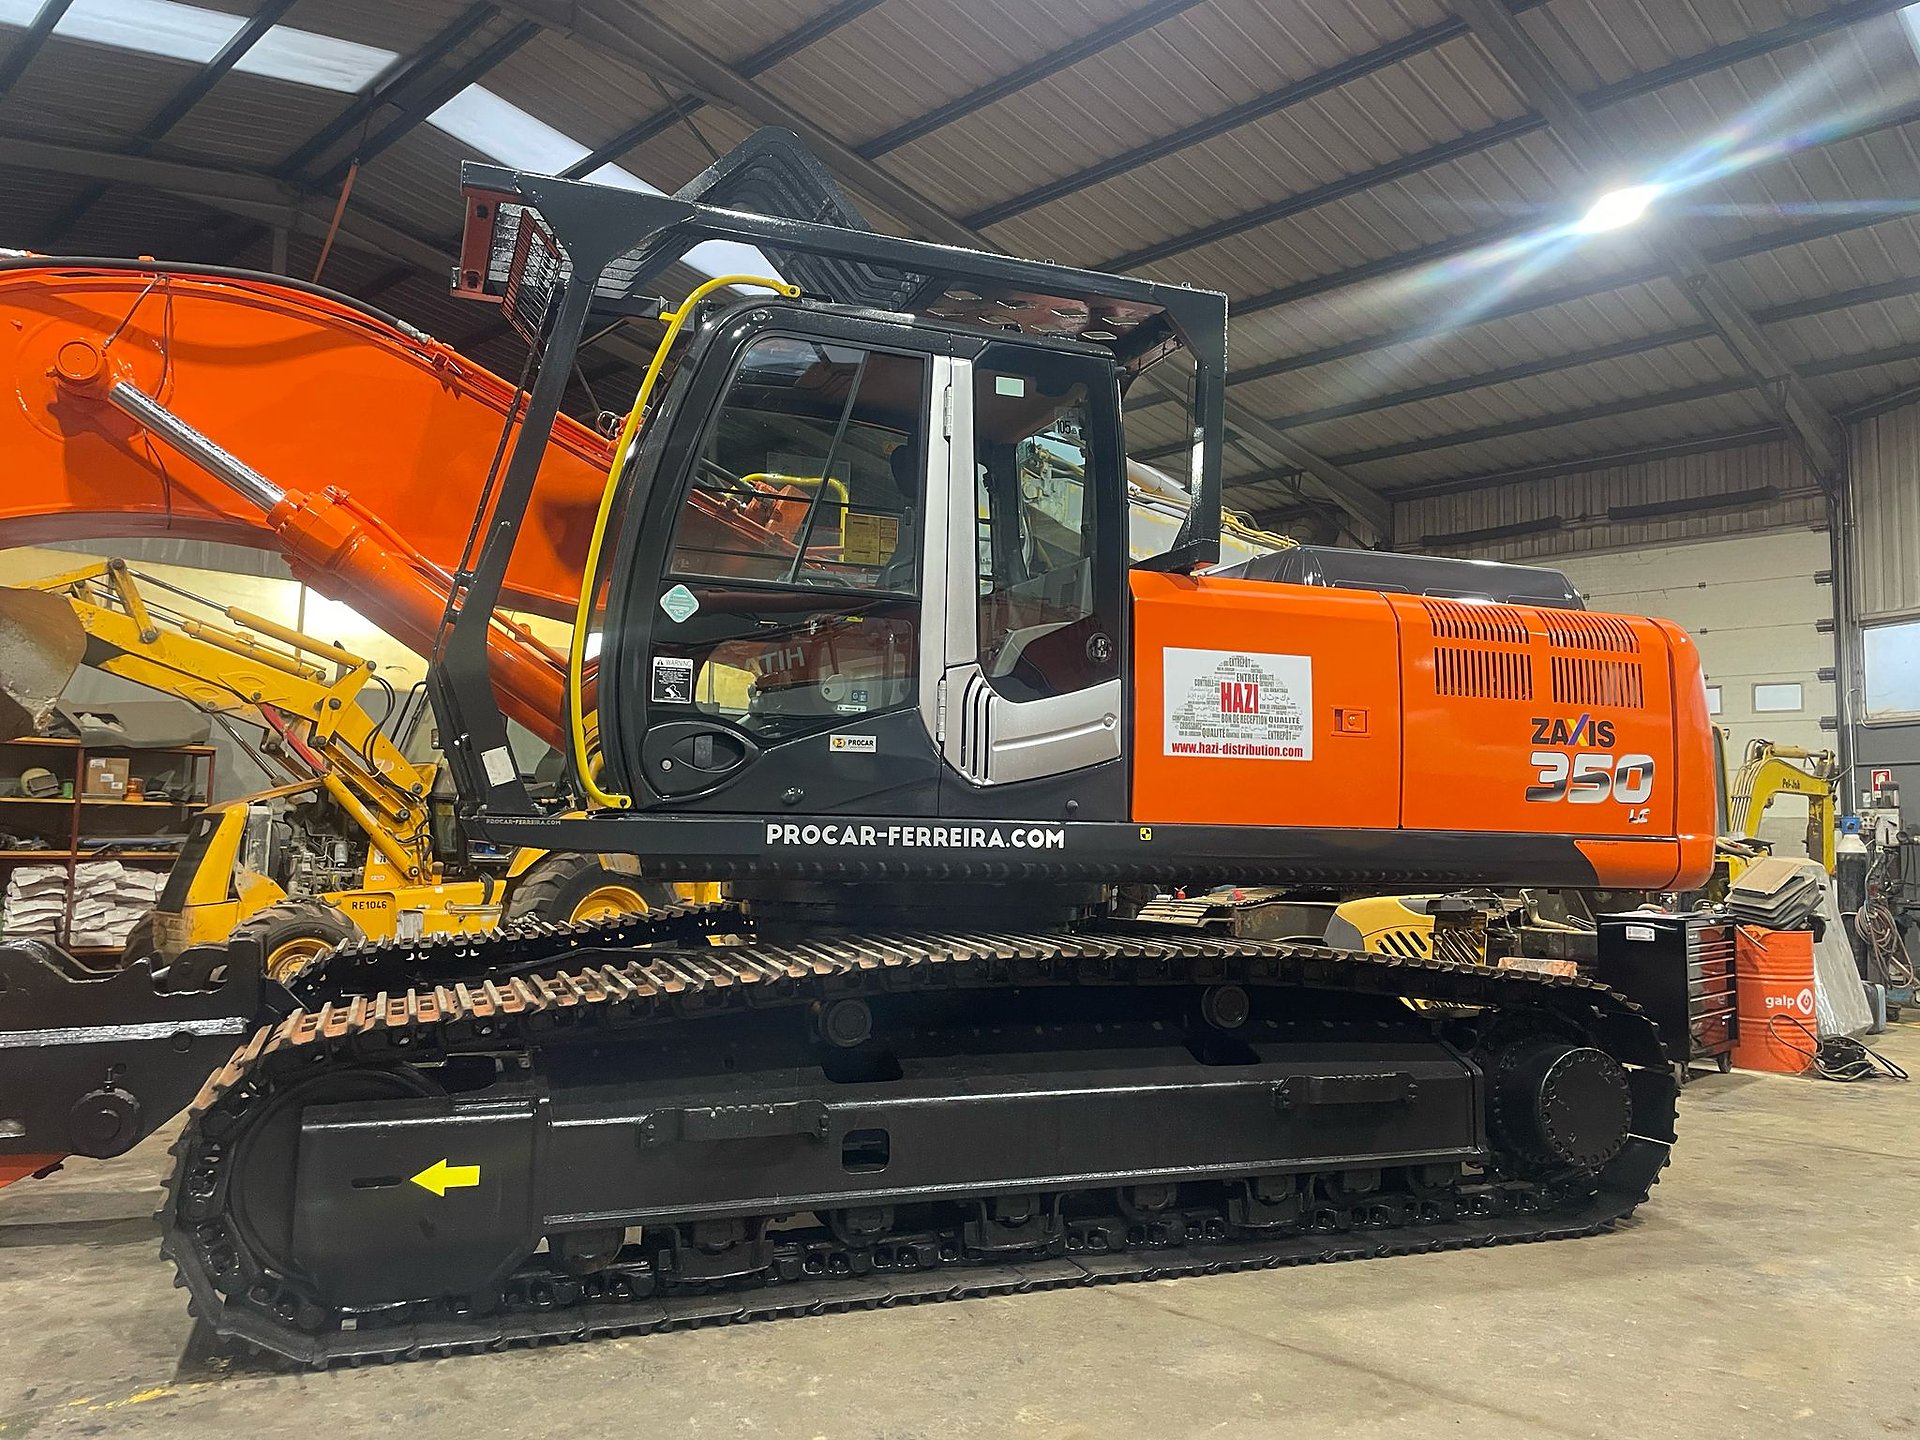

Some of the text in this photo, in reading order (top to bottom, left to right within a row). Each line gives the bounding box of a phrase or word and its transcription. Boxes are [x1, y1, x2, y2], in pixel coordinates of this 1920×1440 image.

[1056, 420, 1071, 434] 105
[665, 659, 691, 667] WARNING
[1220, 681, 1259, 714] HAZI
[1531, 713, 1615, 748] ZAXIS
[848, 739, 874, 747] PROCAR
[1172, 742, 1303, 757] www.hazi-distribution.com
[1525, 751, 1655, 804] 350
[1628, 808, 1651, 824] LC
[765, 823, 1066, 850] PROCAR-FERREIRA.COM
[351, 900, 388, 910] RE1046
[1765, 995, 1795, 1009] galp
